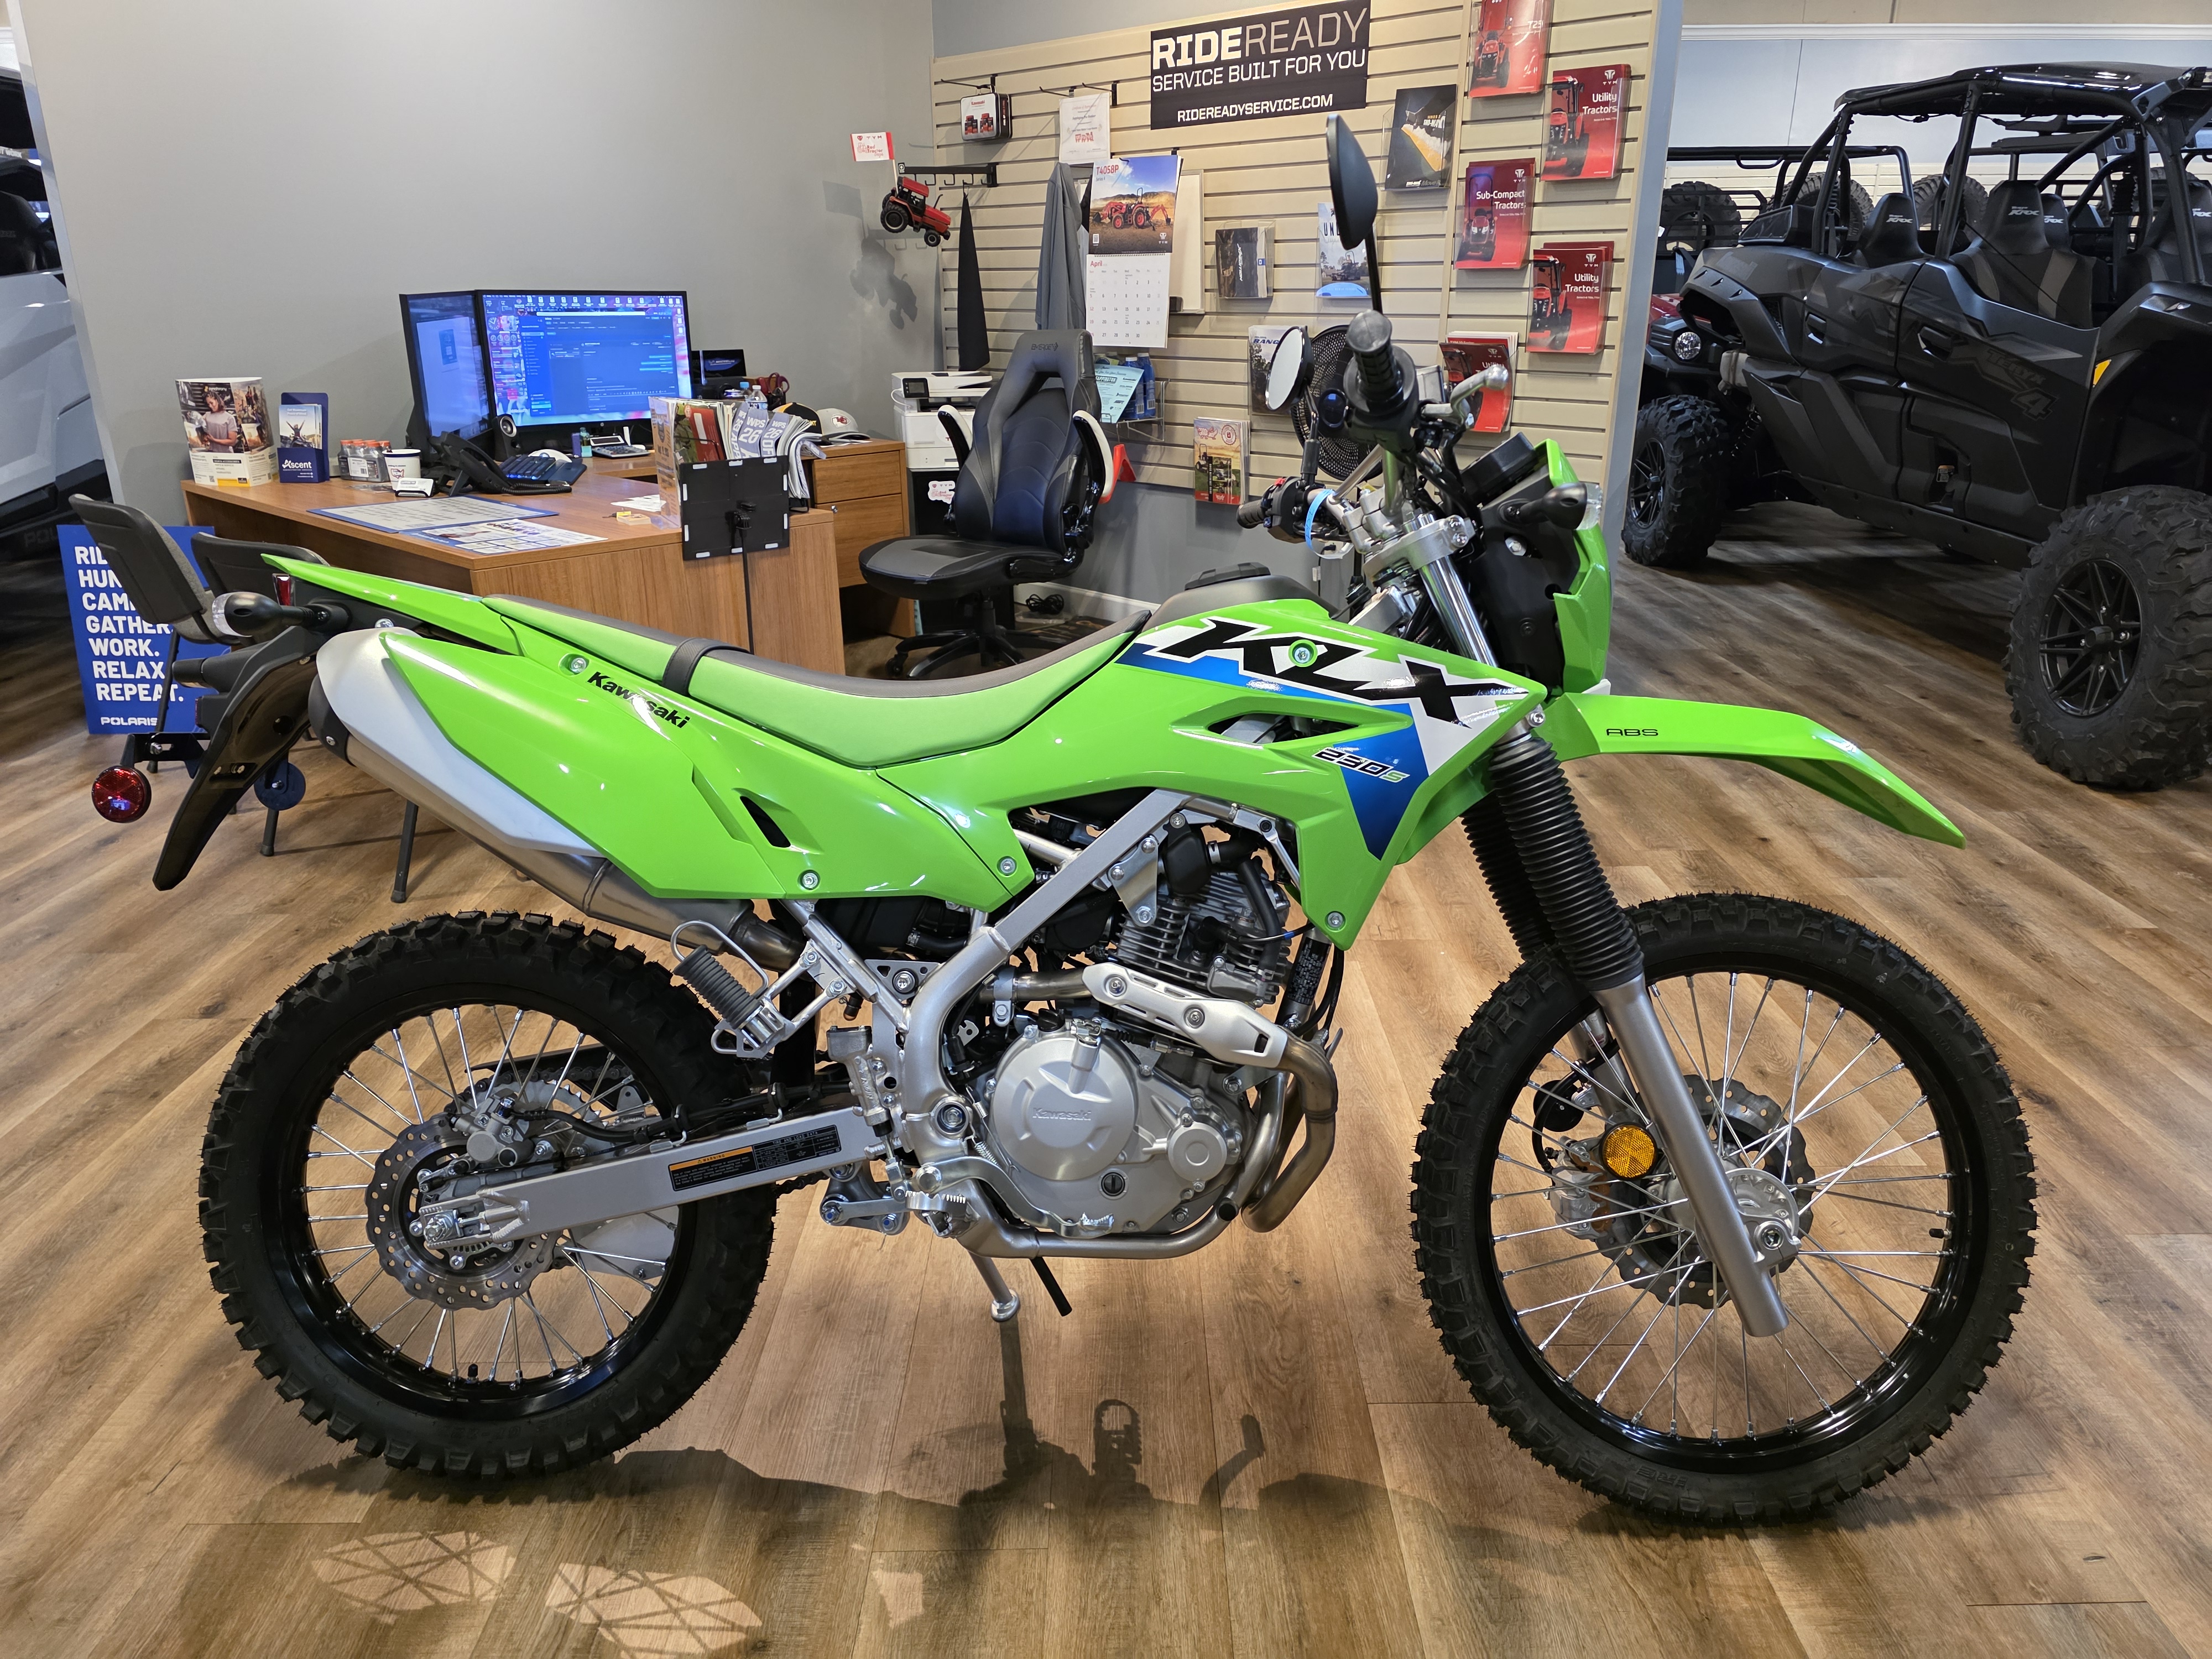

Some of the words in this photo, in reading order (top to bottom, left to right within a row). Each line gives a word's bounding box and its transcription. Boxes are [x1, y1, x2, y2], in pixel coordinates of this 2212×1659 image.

[1152, 8, 1368, 70] RIDEREADY
[1152, 67, 1223, 92] SERVICE
[1229, 60, 1280, 83] BUILT
[1285, 54, 1322, 76] FOR
[1326, 49, 1365, 69] YOU
[1592, 92, 1616, 102] Utility
[1177, 94, 1333, 122] RIDEREADYSERVICE.COM
[1582, 106, 1617, 114] Tractors
[1096, 165, 1119, 175] T4058P
[1476, 190, 1525, 200] Sub-Compact
[1494, 201, 1526, 210] Tractors
[1574, 273, 1599, 283] Utility
[1565, 284, 1599, 293] Tractors
[2014, 389, 2056, 419] 4
[747, 416, 766, 428] WPS
[772, 420, 786, 429] WPS
[738, 427, 763, 444] 26
[764, 428, 783, 438] 26
[282, 460, 312, 469] Ascent
[82, 592, 136, 611] CAM
[88, 638, 160, 657] WORK.
[92, 661, 165, 679] RELAX
[1157, 617, 1530, 729] KLX
[96, 683, 184, 702] REPEAT.
[100, 717, 158, 726] POLARIS
[1606, 728, 1658, 737] ABS
[1314, 747, 1410, 782] 230S
[1032, 1107, 1092, 1121] Kawasaki
